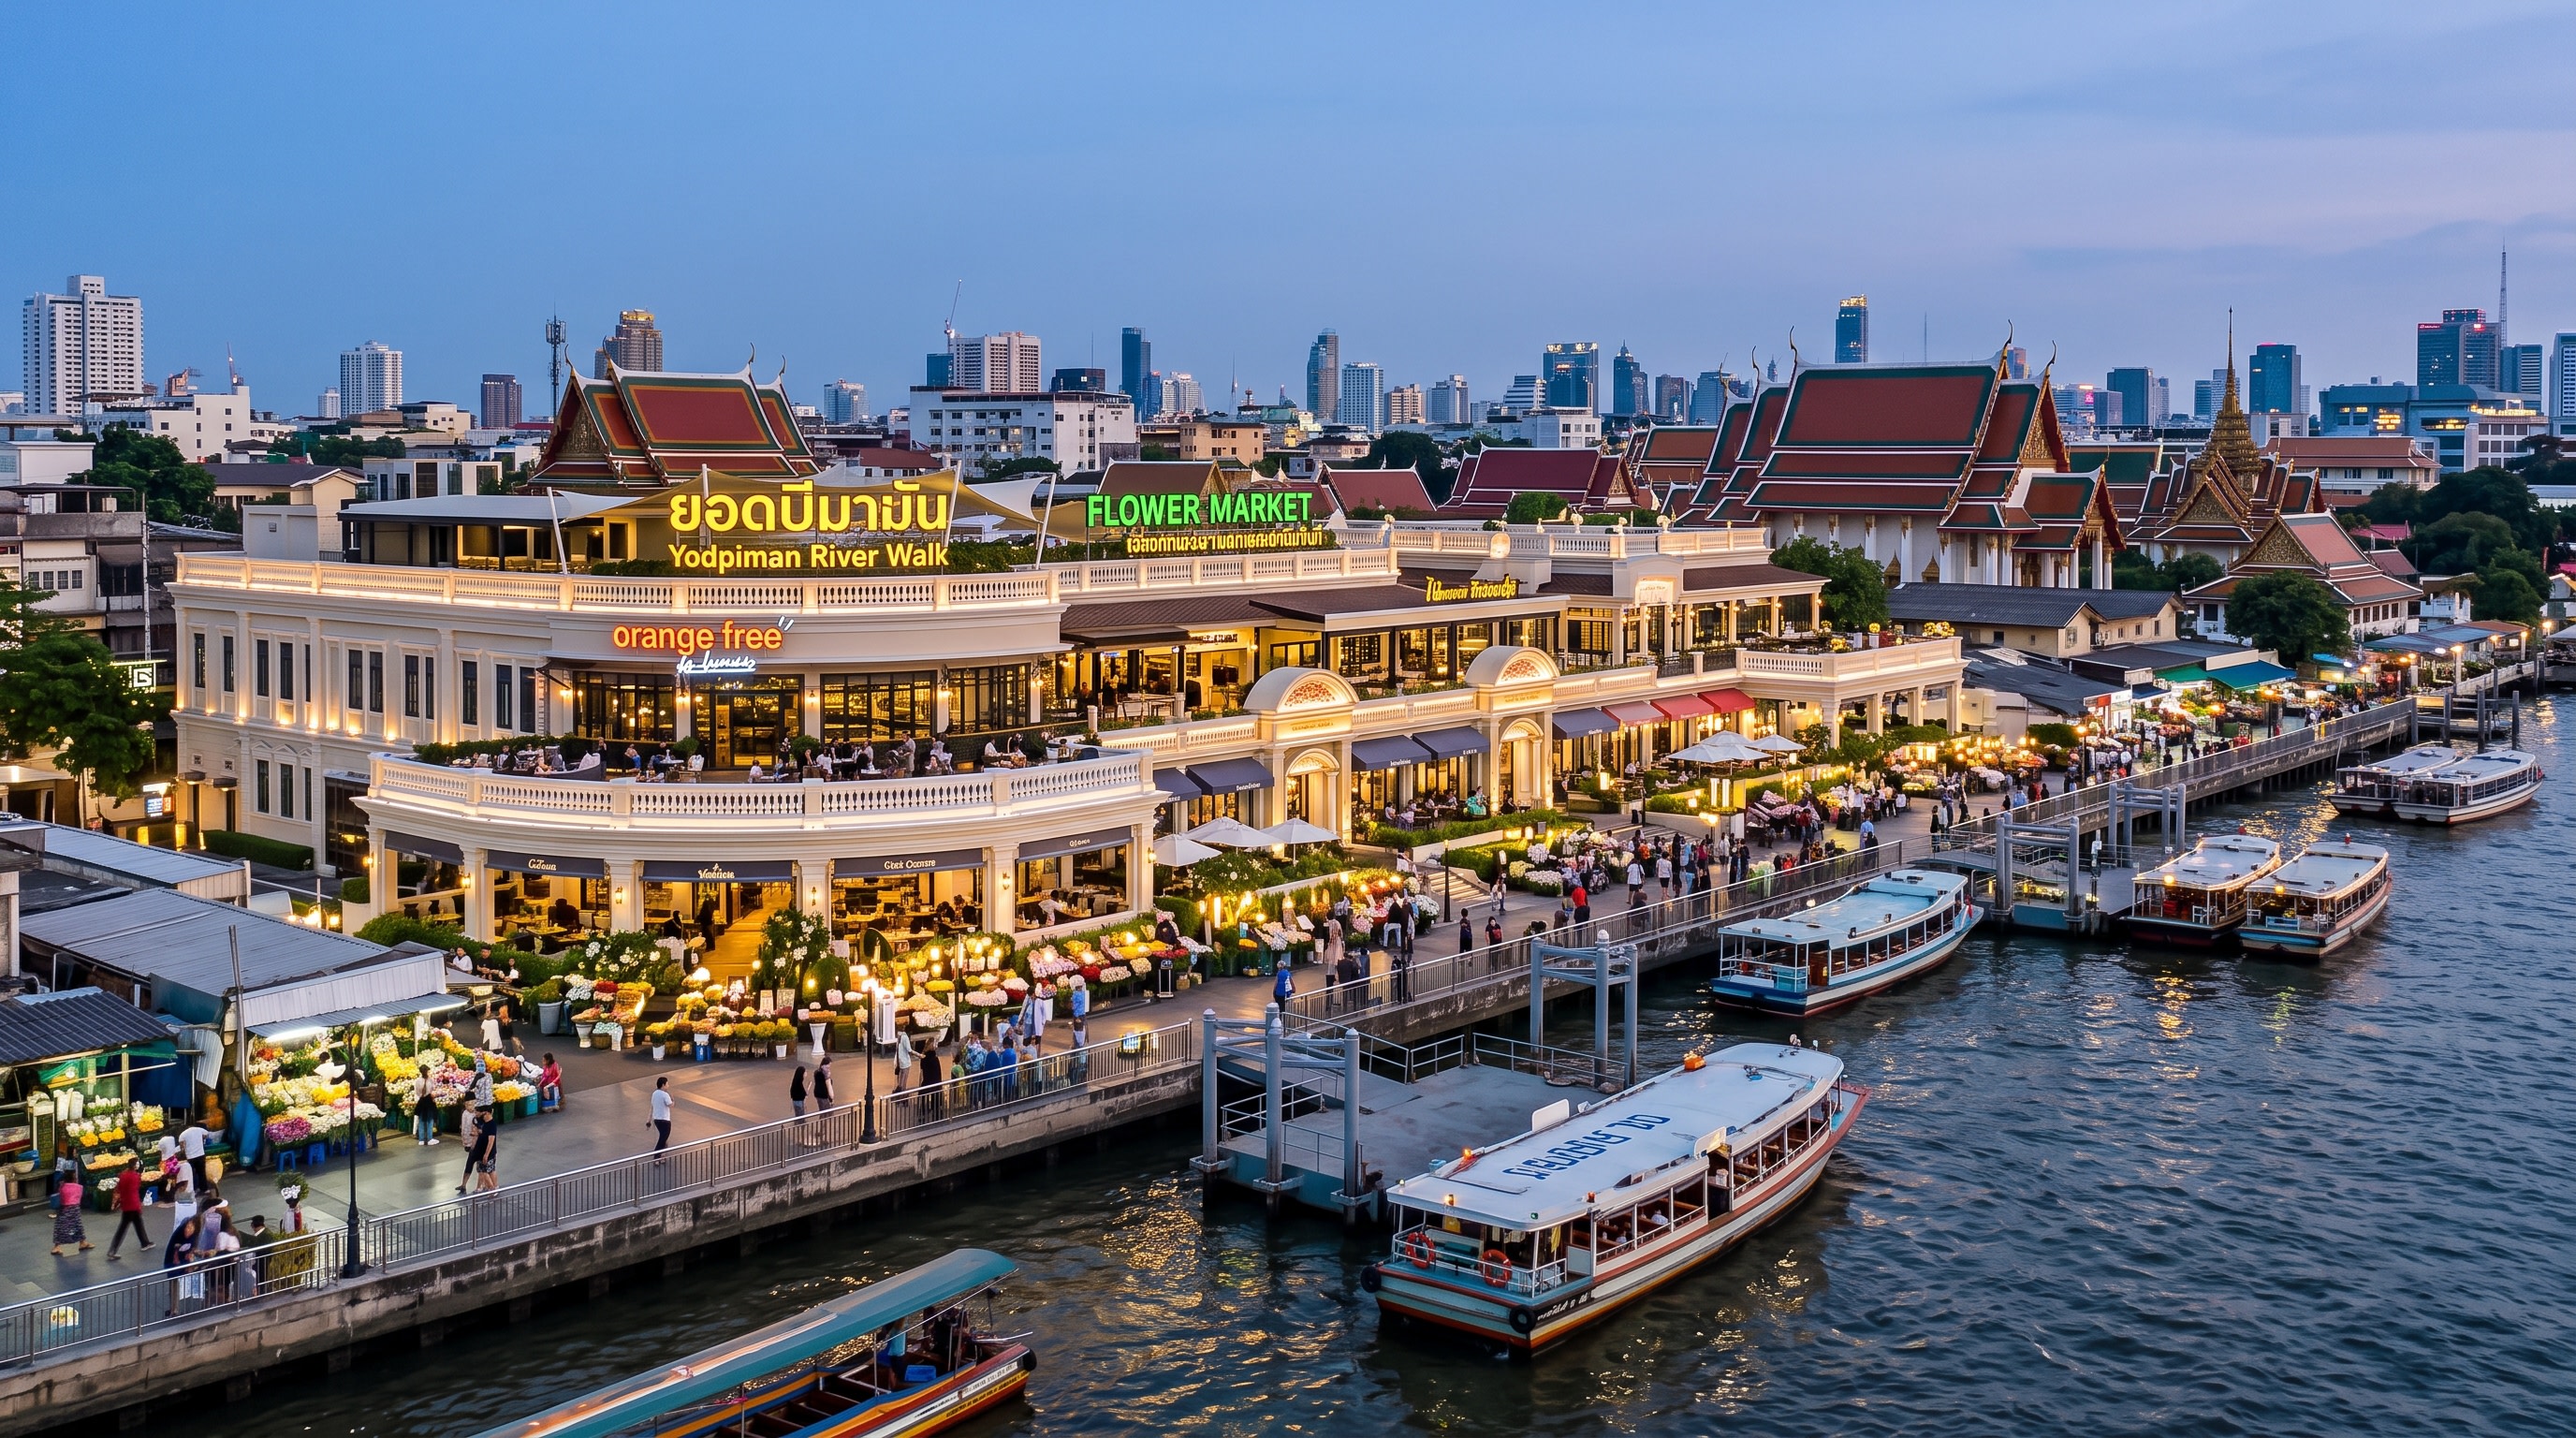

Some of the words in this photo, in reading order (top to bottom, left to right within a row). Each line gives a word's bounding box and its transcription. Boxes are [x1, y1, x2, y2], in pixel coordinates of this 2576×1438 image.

[1087, 493, 1201, 527] FLOWER
[1209, 492, 1313, 524] MARKET
[667, 543, 801, 574] Yodpiman
[811, 543, 879, 568] River
[886, 541, 949, 567] Walk
[613, 624, 715, 656] orange
[722, 620, 783, 651] free
